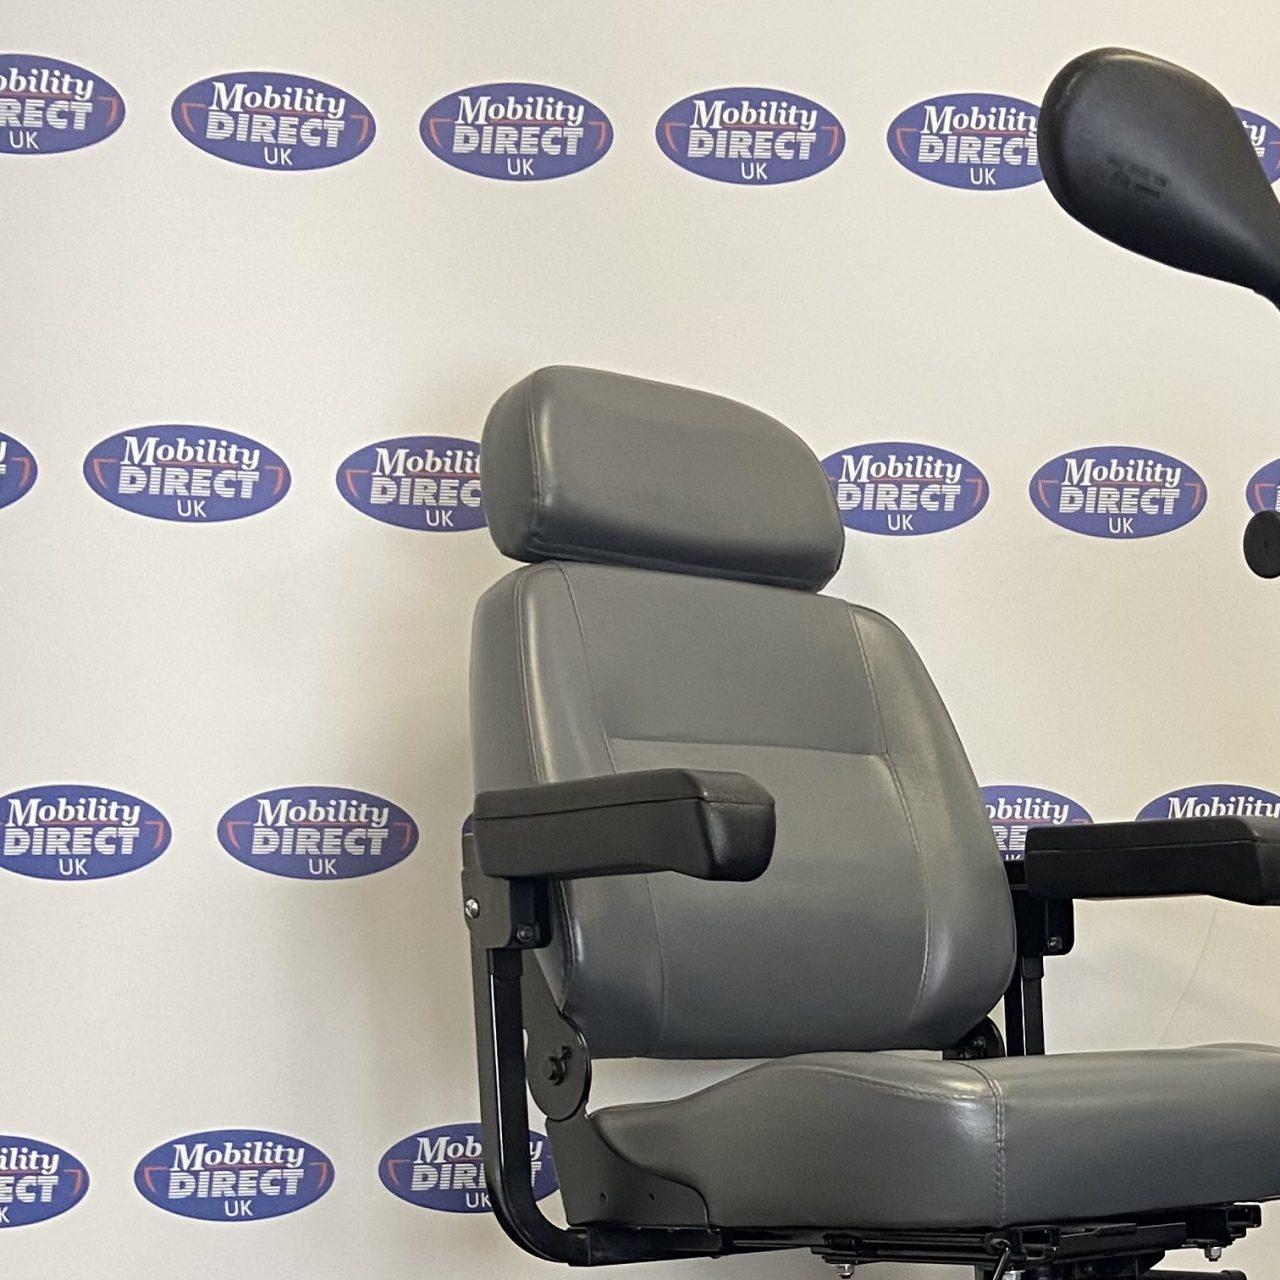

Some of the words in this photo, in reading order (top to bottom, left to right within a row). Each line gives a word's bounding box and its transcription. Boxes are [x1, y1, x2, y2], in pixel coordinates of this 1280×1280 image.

[0, 98, 93, 130] RECT
[208, 82, 345, 119] Mobility
[455, 96, 584, 126] Mobility
[690, 100, 817, 131] Mobility
[9, 130, 39, 149] UK
[206, 112, 345, 147] DIRECT
[453, 126, 583, 155] DIRECT
[264, 147, 292, 165] UK
[688, 130, 816, 159] DIRECT
[918, 135, 1037, 165] DIRECT
[508, 158, 534, 175] UK
[742, 163, 767, 179] UK
[970, 167, 996, 185] UK
[120, 436, 259, 470] Mobility
[119, 466, 259, 498] DIRECT
[838, 455, 962, 484] Mobility
[1062, 459, 1181, 487] Mobility
[177, 500, 206, 517] UK
[837, 484, 961, 511] DIRECT
[1059, 487, 1180, 514] DIRECT
[426, 510, 453, 527] UK
[888, 514, 913, 530] UK
[1109, 518, 1133, 533] UK
[5, 798, 140, 826] Mobility
[254, 800, 388, 827] Mobility
[1167, 796, 1280, 819] Mobility
[4, 827, 139, 855] DIRECT
[252, 828, 388, 854] DIRECT
[59, 859, 87, 875] UK
[310, 859, 336, 874] UK
[170, 1142, 304, 1172] Mobility
[169, 1169, 303, 1198] DIRECT
[225, 1200, 252, 1216] UK
[465, 1192, 492, 1208] UK
